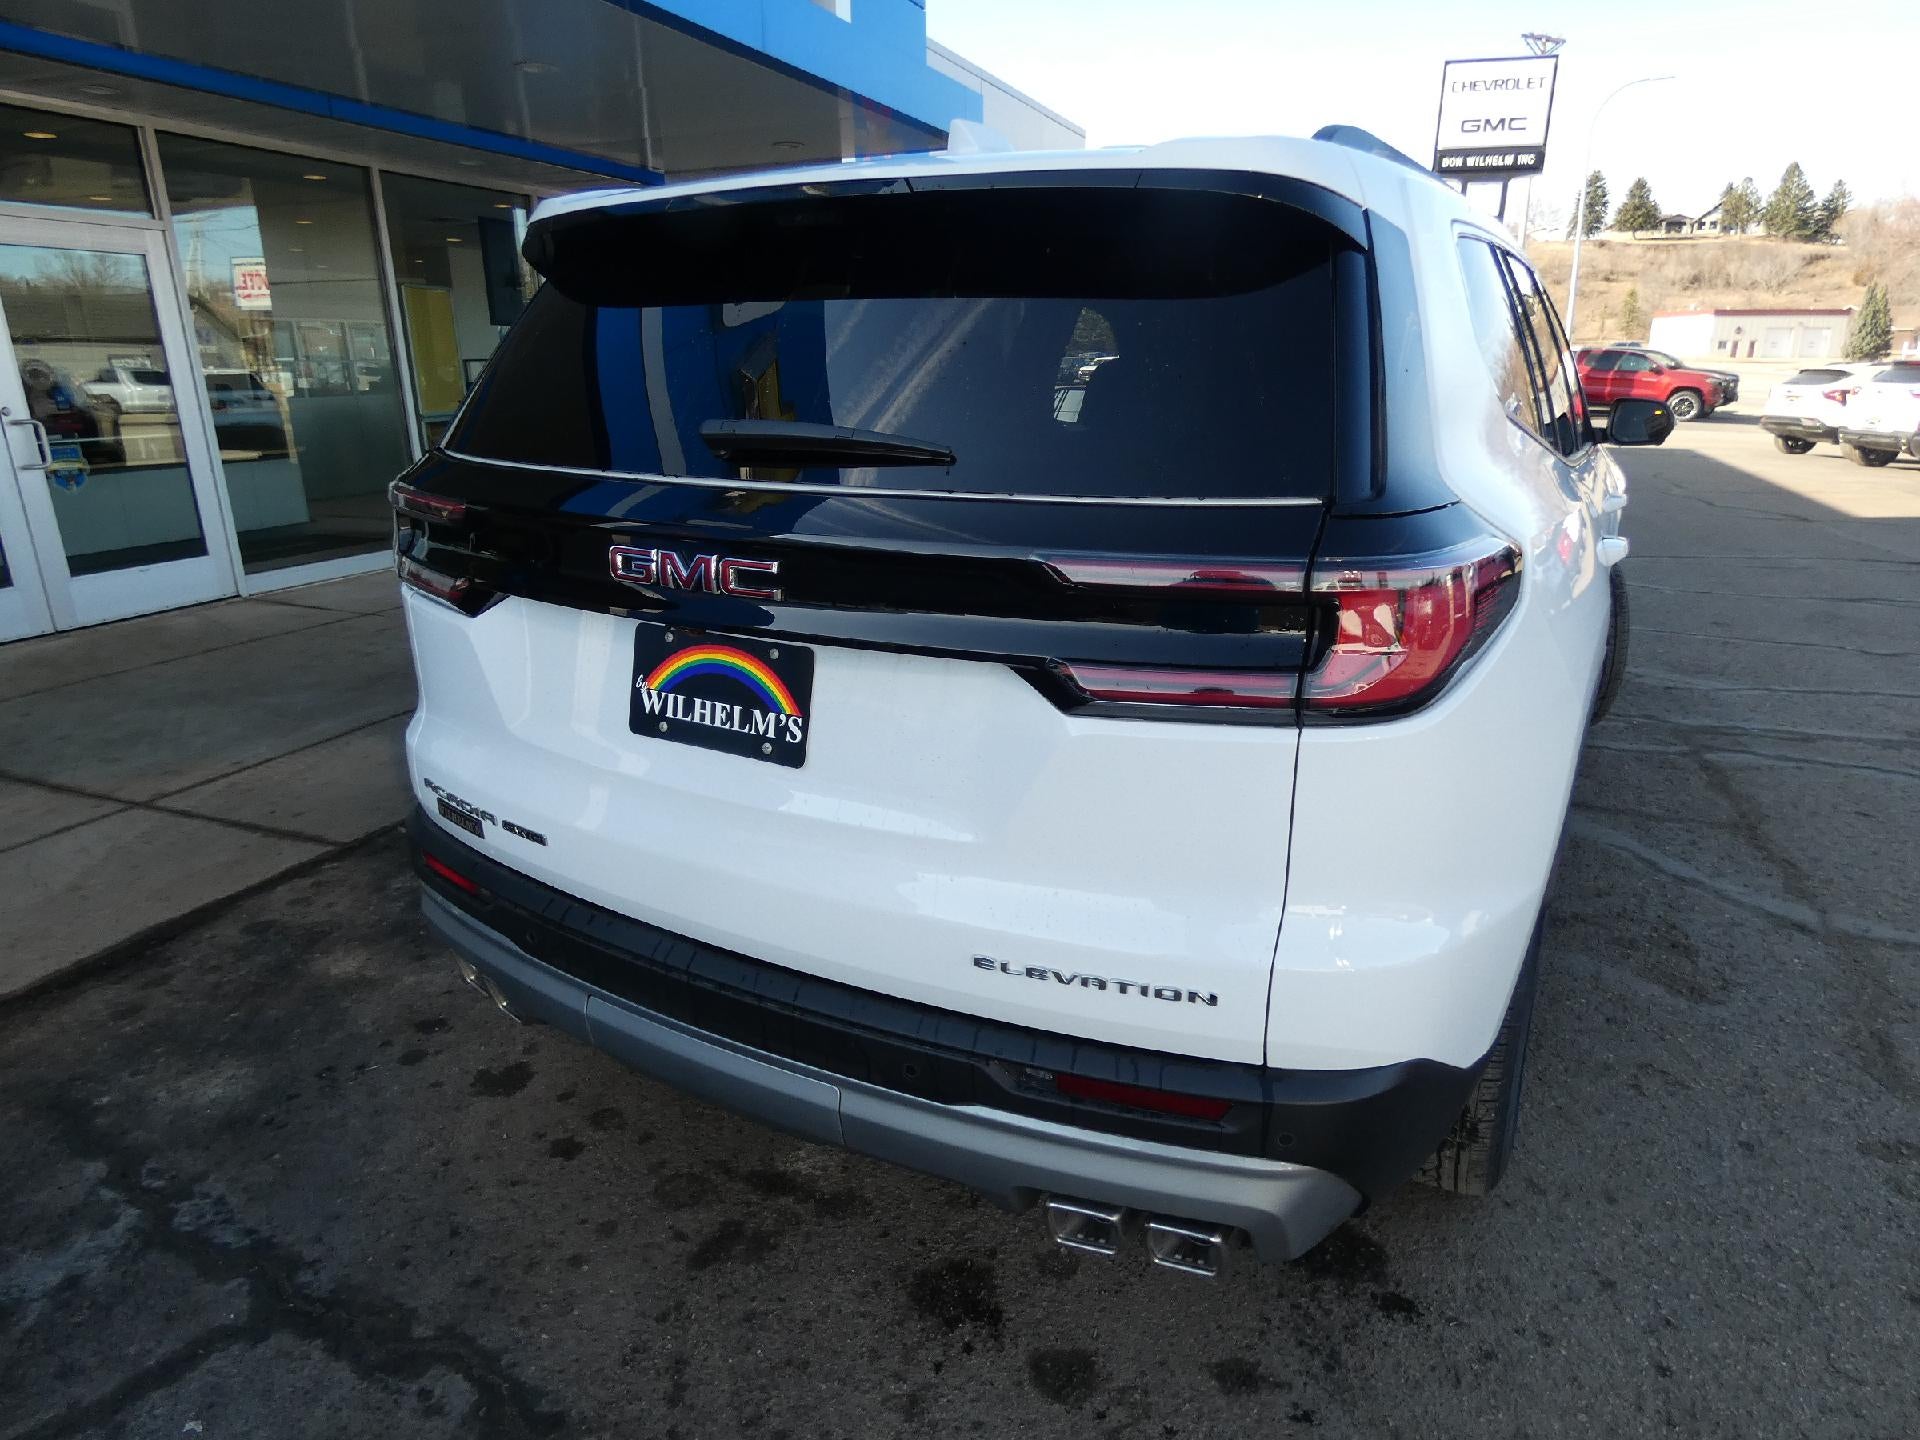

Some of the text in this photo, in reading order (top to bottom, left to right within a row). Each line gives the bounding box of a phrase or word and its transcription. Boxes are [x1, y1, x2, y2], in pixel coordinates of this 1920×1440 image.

[1451, 77, 1547, 93] CHEVROLET
[1461, 117, 1527, 133] GMC
[1466, 154, 1515, 167] WILHELM
[609, 545, 783, 602] GMC
[640, 689, 803, 744] WILHELM'S
[972, 953, 1219, 1007] ELEVATION
